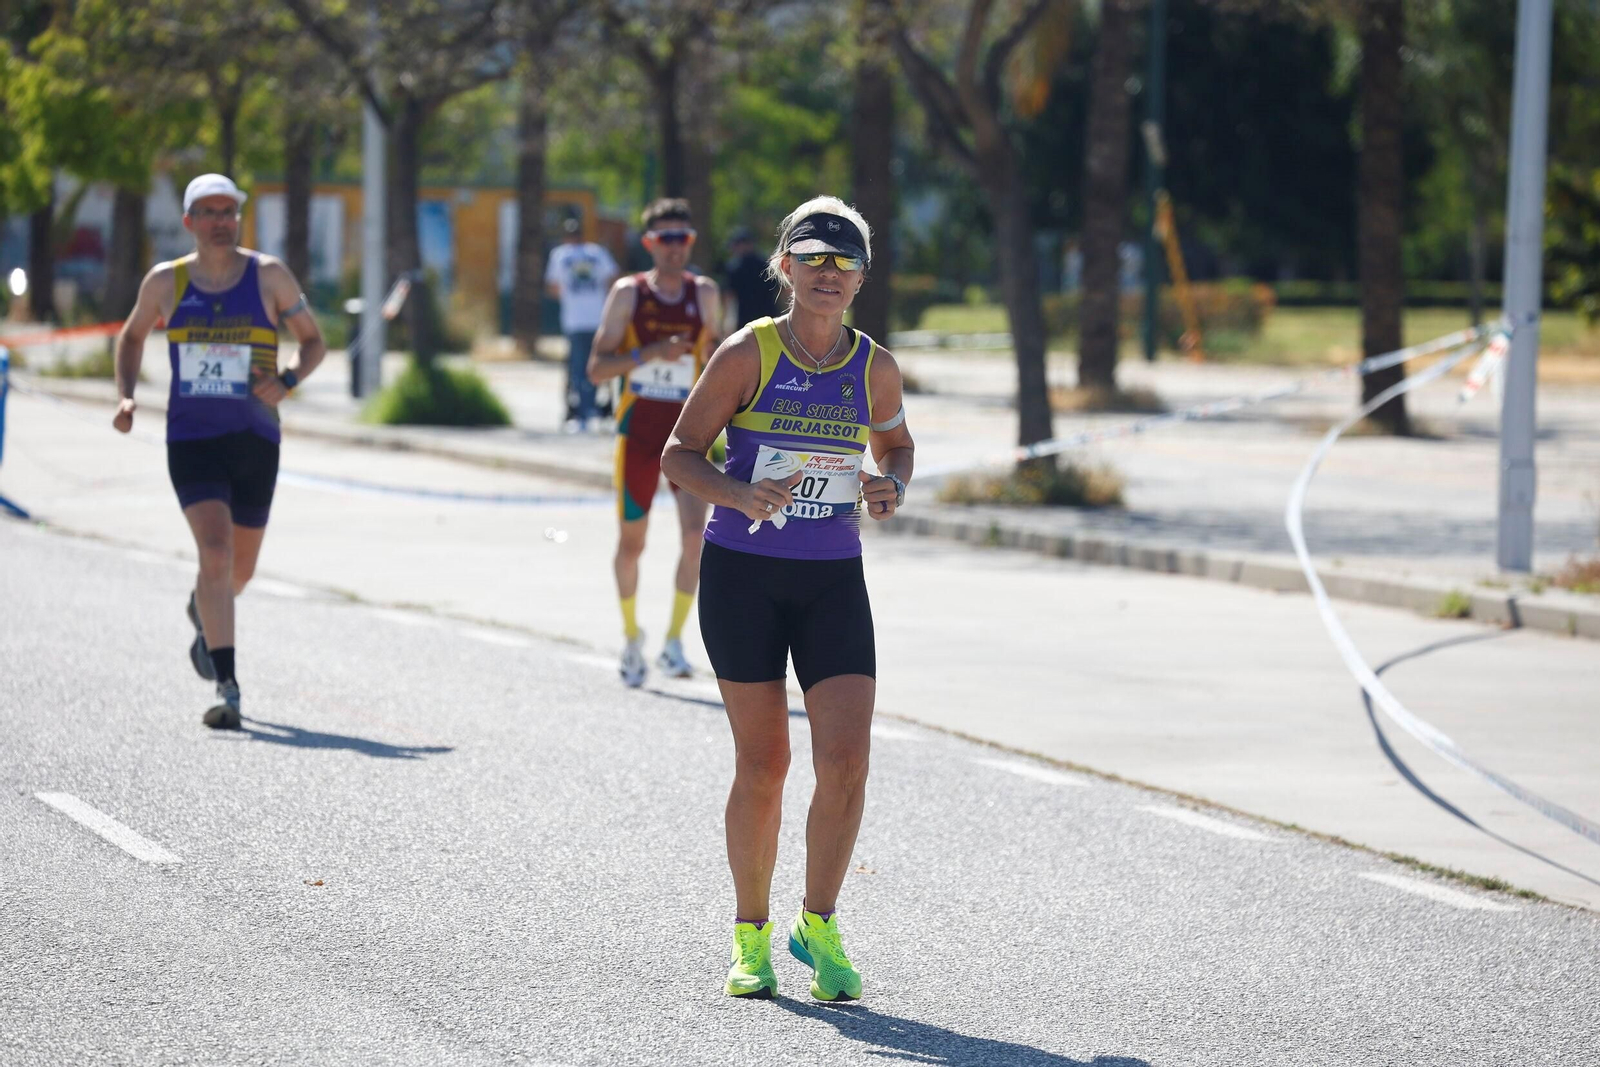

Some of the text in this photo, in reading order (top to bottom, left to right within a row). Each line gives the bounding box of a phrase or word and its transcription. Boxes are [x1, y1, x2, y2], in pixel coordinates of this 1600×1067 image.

[199, 360, 222, 377] 24
[652, 367, 673, 382] 14
[775, 384, 809, 392] MERCURY
[772, 398, 858, 422] ELS SITGES
[770, 418, 860, 439] BURJASSOT
[810, 456, 845, 464] RFEA
[781, 501, 833, 519] oma
